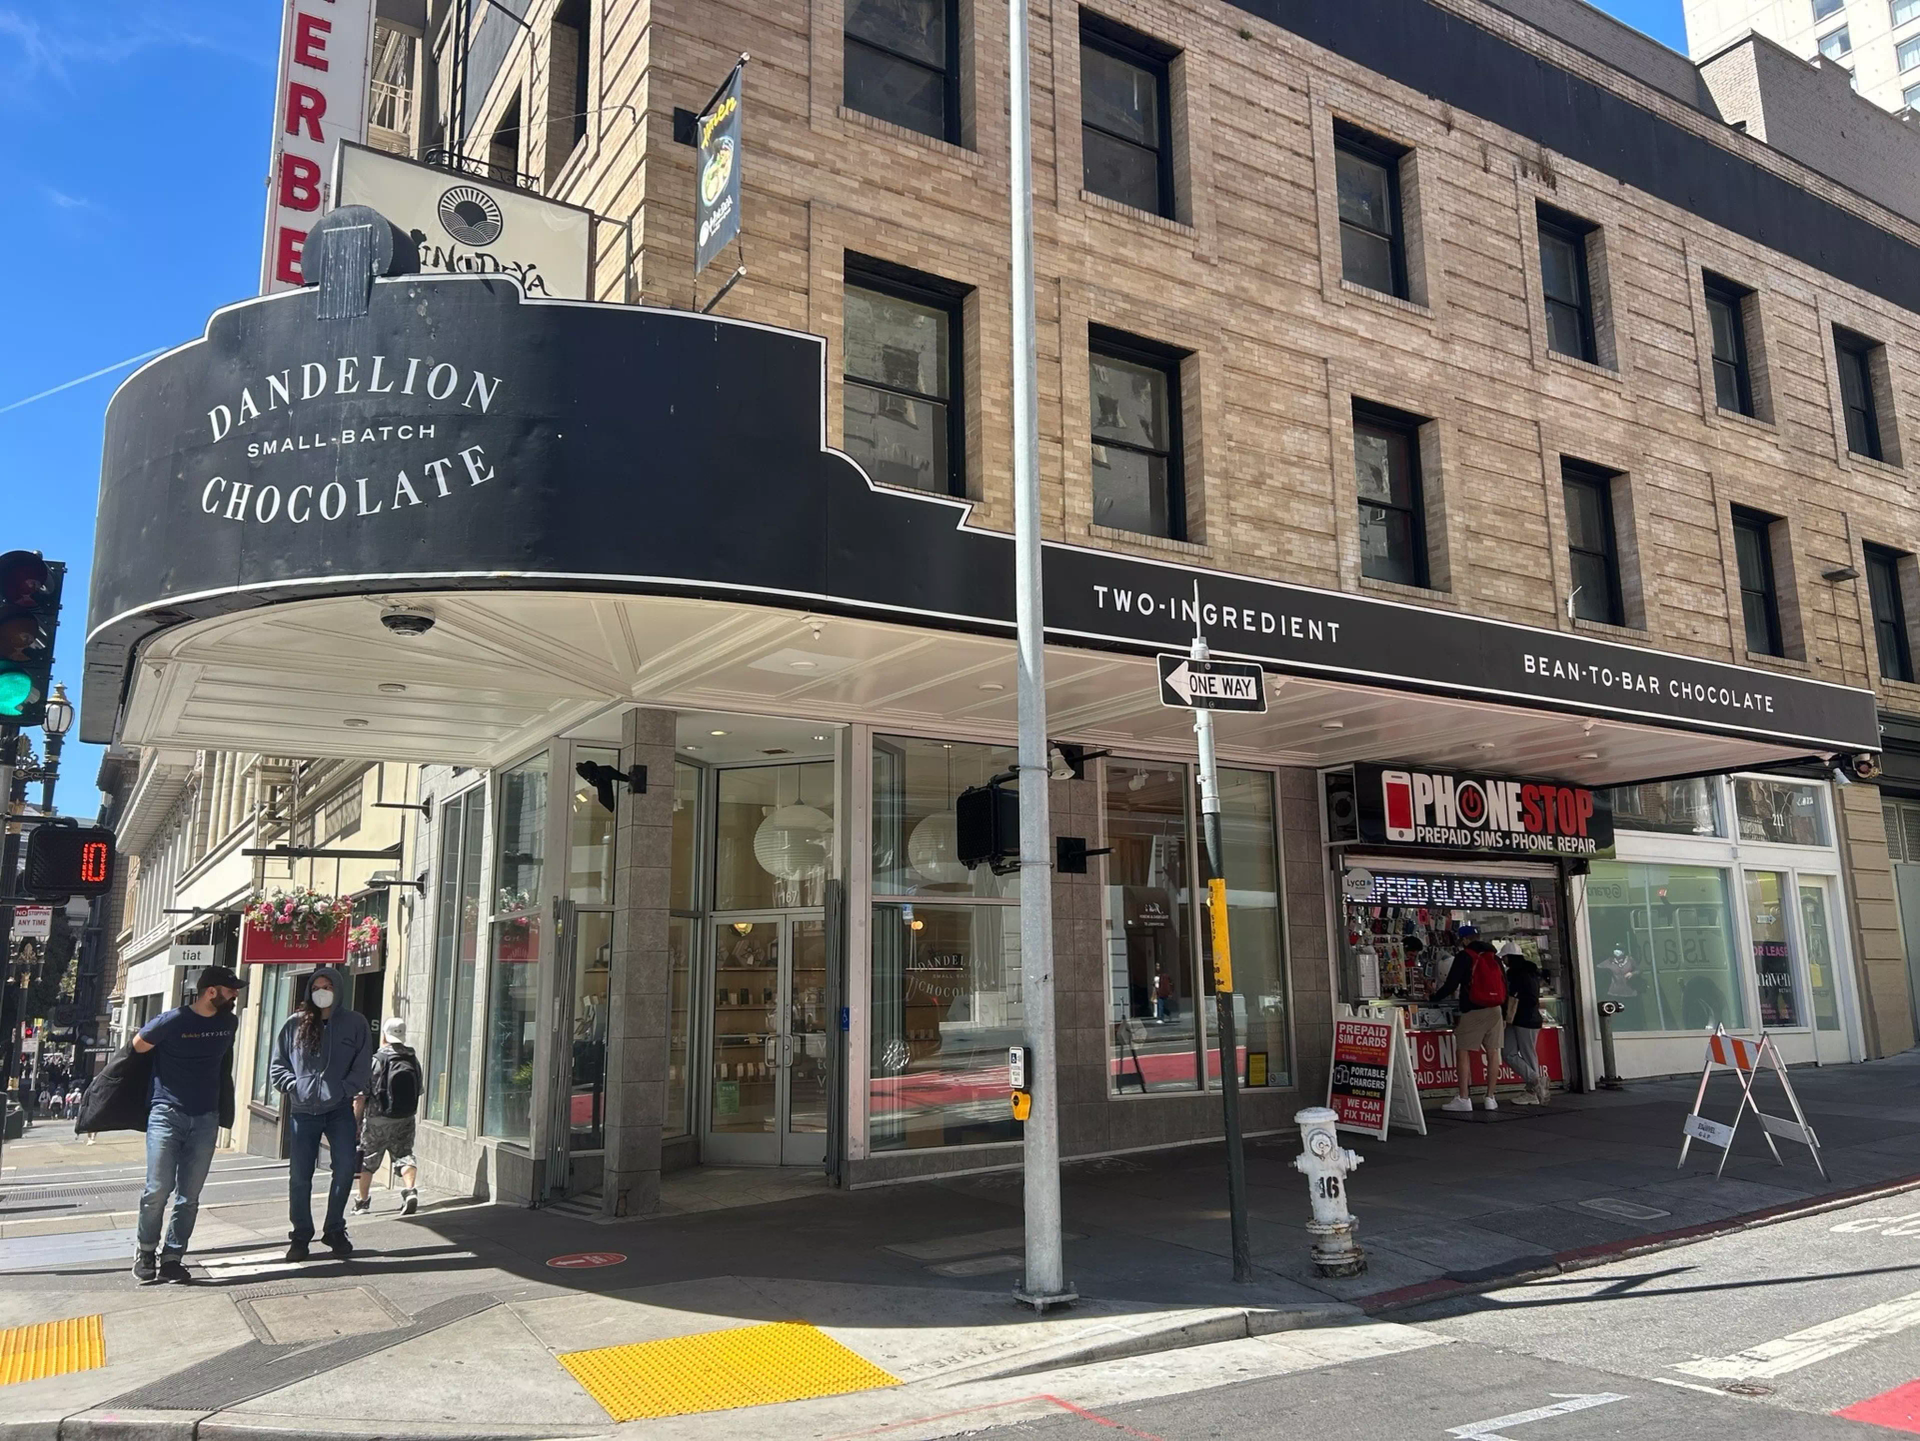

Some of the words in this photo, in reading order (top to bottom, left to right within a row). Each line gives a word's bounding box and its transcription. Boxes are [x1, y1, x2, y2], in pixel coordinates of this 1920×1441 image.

[276, 2, 332, 287] ERBE
[206, 355, 502, 444] DANDELION
[246, 424, 436, 459] SMALL-BATCH
[201, 444, 495, 524] CHOCOLATE
[1093, 584, 1340, 643] TWO-INGREDIENT
[1189, 673, 1218, 696] ONE
[1222, 677, 1252, 697] WAY
[1523, 653, 1661, 695] BEAN-TO-BAR
[1669, 679, 1775, 713] CHOCOLATE
[1416, 826, 1471, 846] PREPAID
[1473, 830, 1503, 848] SIMS
[1512, 833, 1553, 851] PHONE
[1557, 837, 1597, 854] REPAIR
[1346, 878, 1366, 888] Lyca
[782, 890, 797, 904] 167
[275, 933, 318, 941] HOTEL
[182, 949, 202, 961] tiat
[1753, 945, 1764, 956] OR
[1337, 1034, 1354, 1045] SIM
[1356, 1036, 1388, 1049] CARDS
[1350, 1066, 1386, 1079] PORTABLE
[1413, 1071, 1435, 1085] PAID
[1483, 1067, 1515, 1081] PONE
[1349, 1077, 1386, 1090] CHARGERS
[1351, 1088, 1366, 1096] SOLD
[1366, 1090, 1381, 1098] HERE
[1347, 1097, 1360, 1108] WE
[1361, 1099, 1380, 1111] CAN
[1343, 1109, 1358, 1119] FIX
[1359, 1111, 1382, 1123] THAT
[1318, 1176, 1340, 1199] 16
